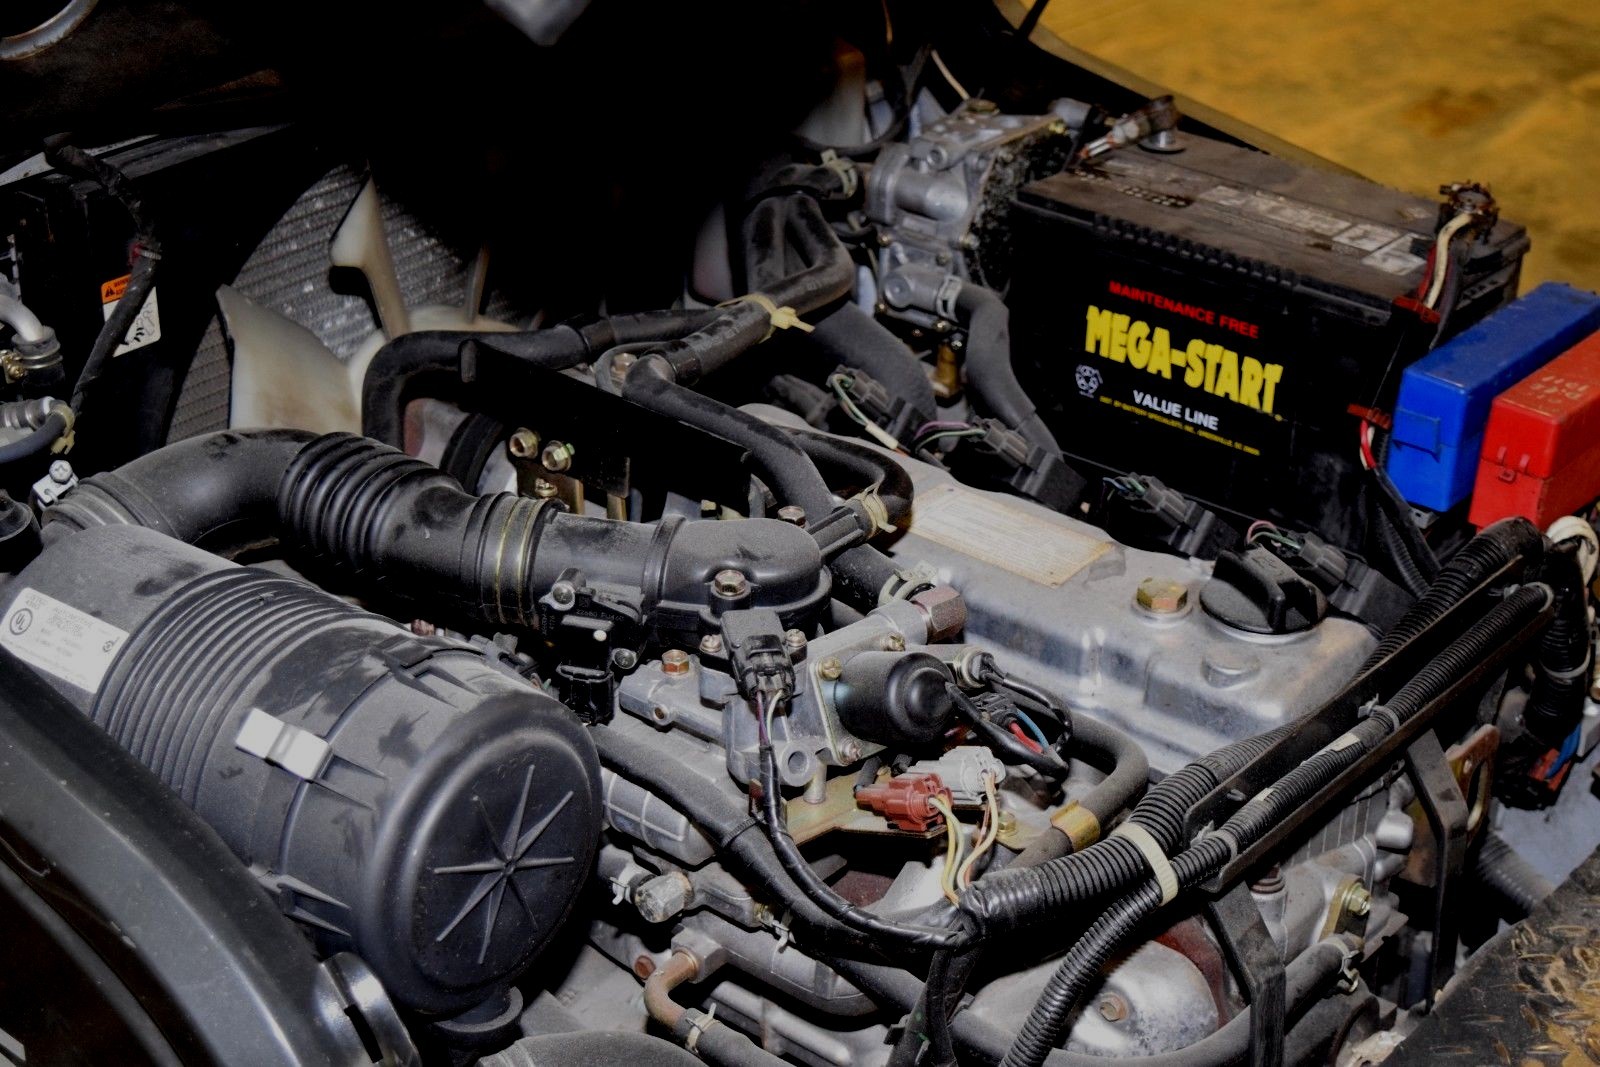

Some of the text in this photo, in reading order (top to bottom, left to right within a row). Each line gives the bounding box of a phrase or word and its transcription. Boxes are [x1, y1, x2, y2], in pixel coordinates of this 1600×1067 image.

[1108, 280, 1259, 338] MAINTENANCE FREE
[1085, 305, 1283, 414] MEGA-START
[1133, 389, 1182, 418] VALUE
[1184, 408, 1219, 431] LINE
